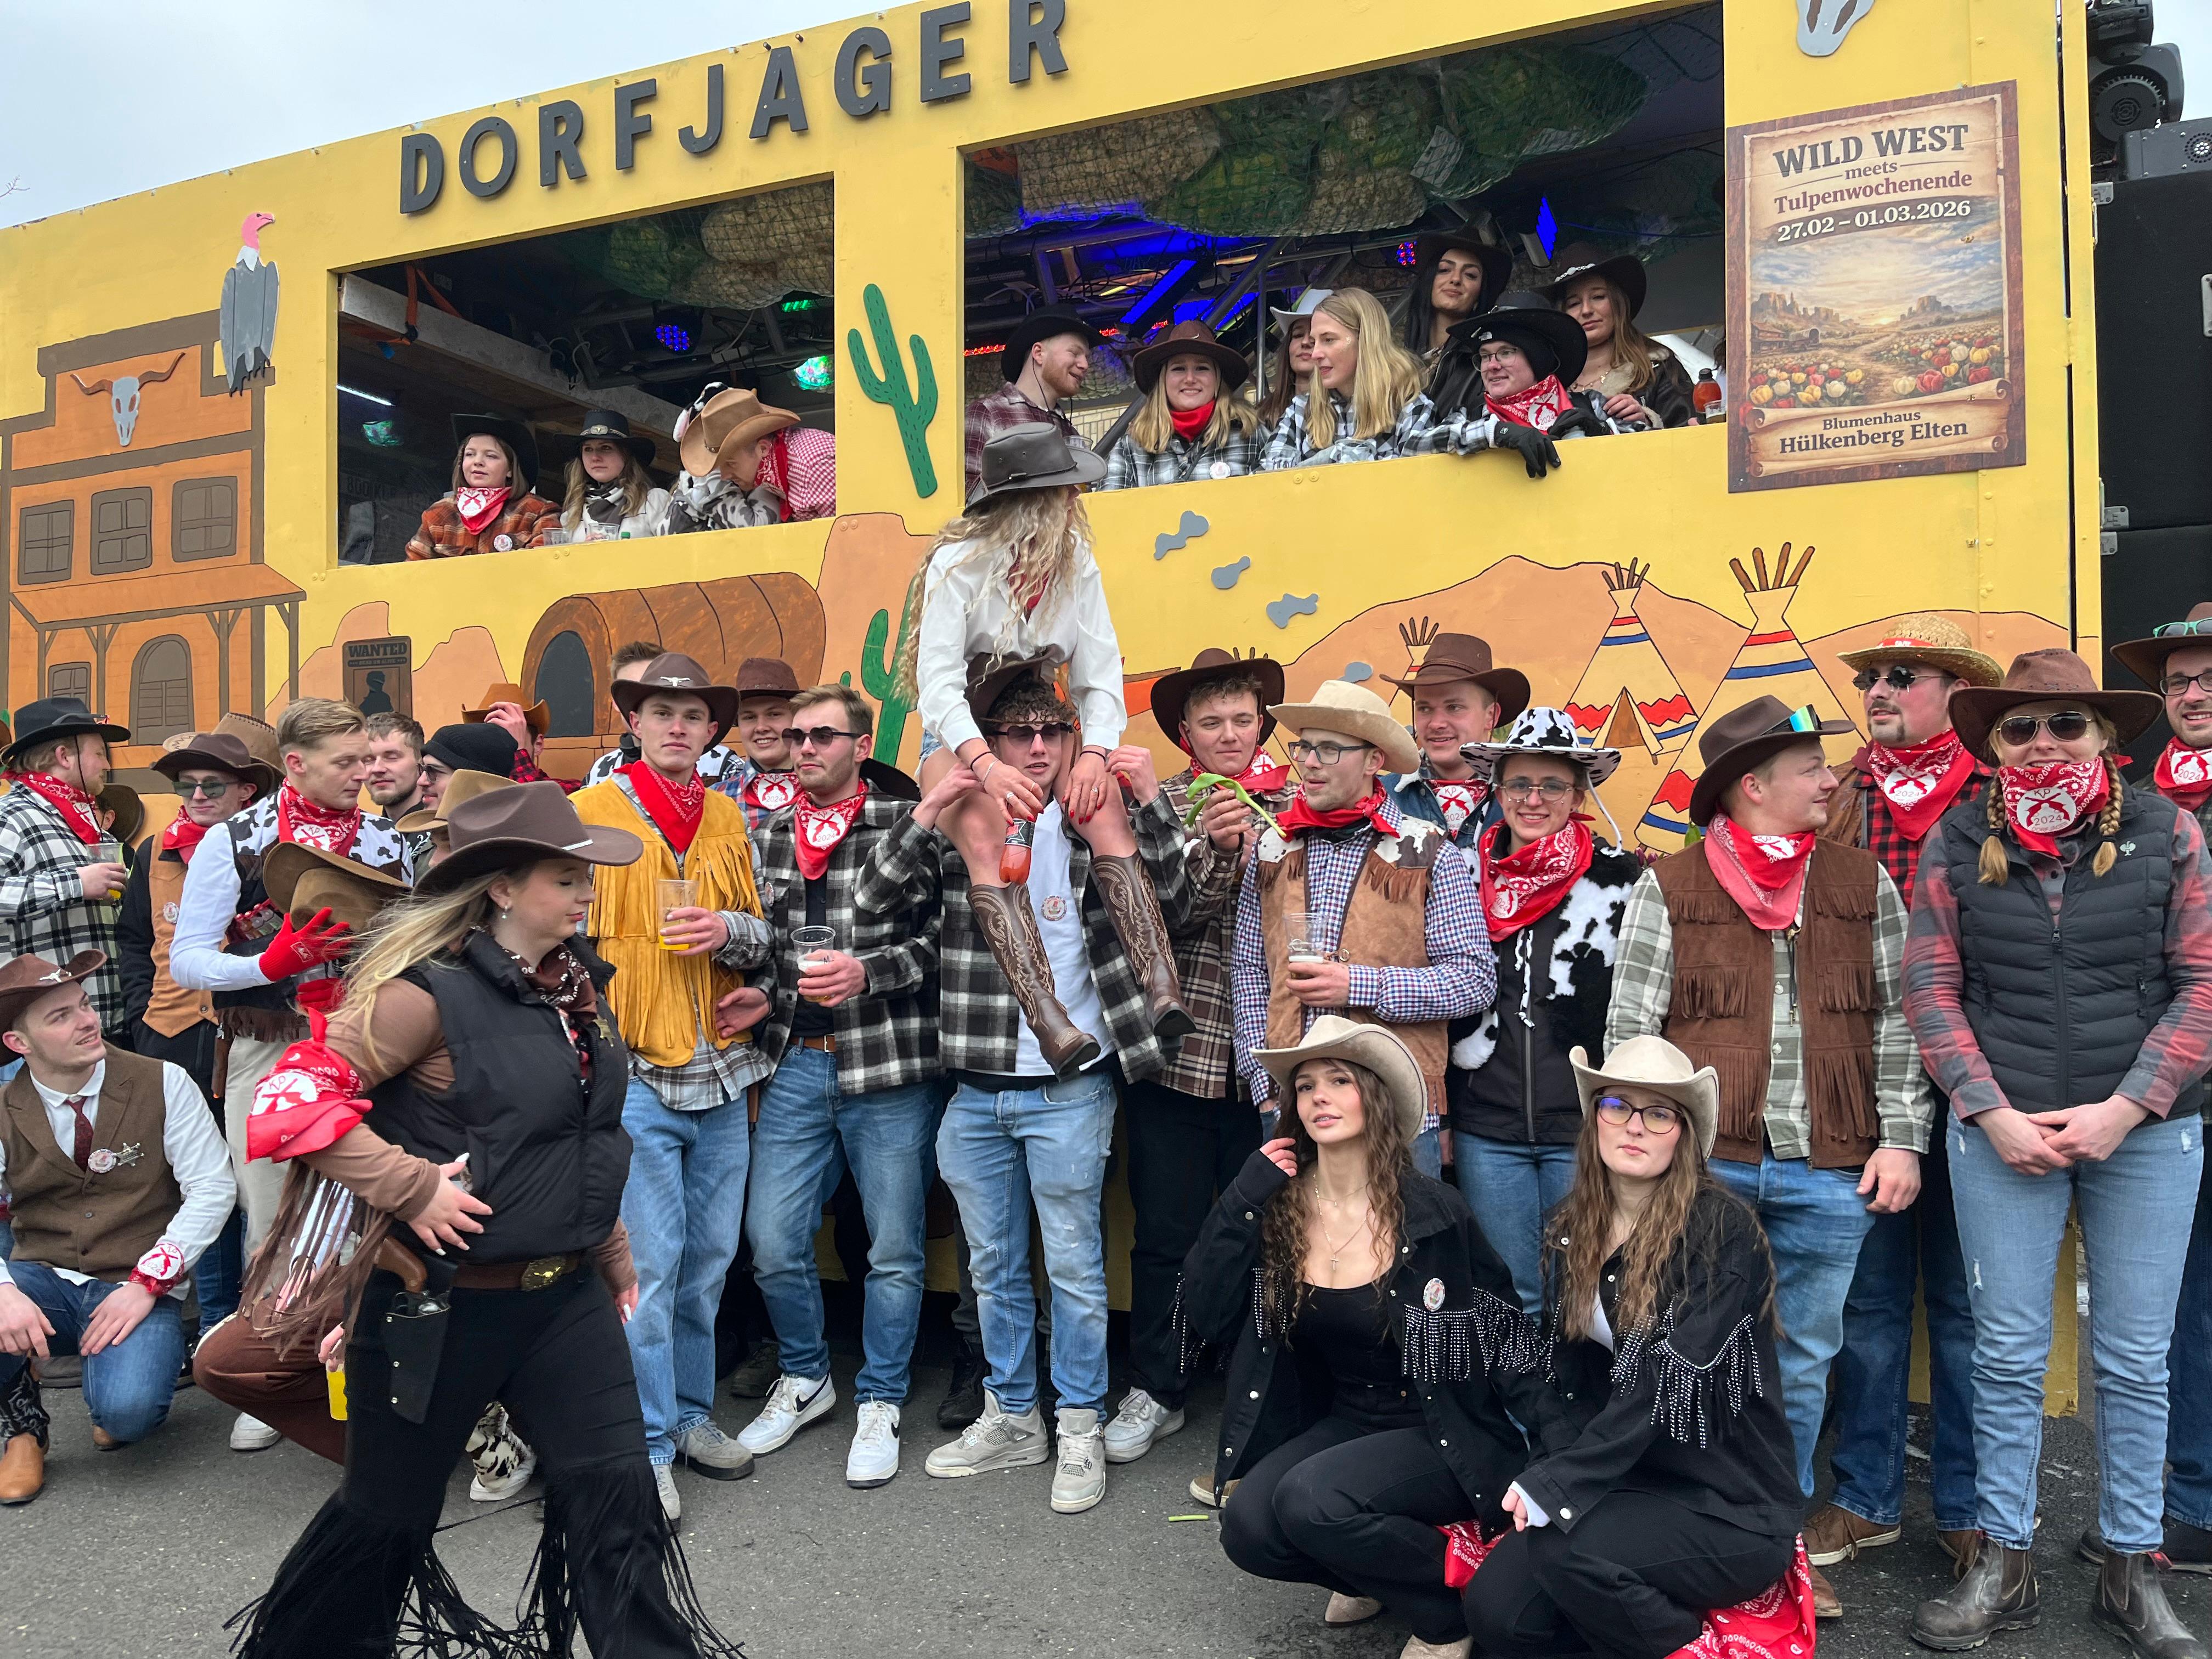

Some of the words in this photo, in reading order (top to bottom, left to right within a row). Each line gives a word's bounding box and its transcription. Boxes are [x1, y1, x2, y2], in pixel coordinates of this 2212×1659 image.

[1773, 136, 1863, 178] WILD
[1871, 125, 1968, 157] WEST
[1844, 161, 1898, 180] meets
[1774, 170, 1972, 214] Tulpenwochenende
[1778, 216, 1835, 242] 27.02
[1854, 200, 1971, 227] 01.03.2026
[1539, 414, 1555, 425] 2024
[1822, 411, 1921, 431] Blumenhaus
[1779, 430, 1905, 454] Hülkenberg
[1910, 422, 1968, 441] Elten
[348, 642, 407, 658] WANTED
[2178, 769, 2200, 780] 2024
[1446, 812, 1465, 822] 2024
[2033, 814, 2062, 826] 2024
[817, 832, 835, 842] 2024
